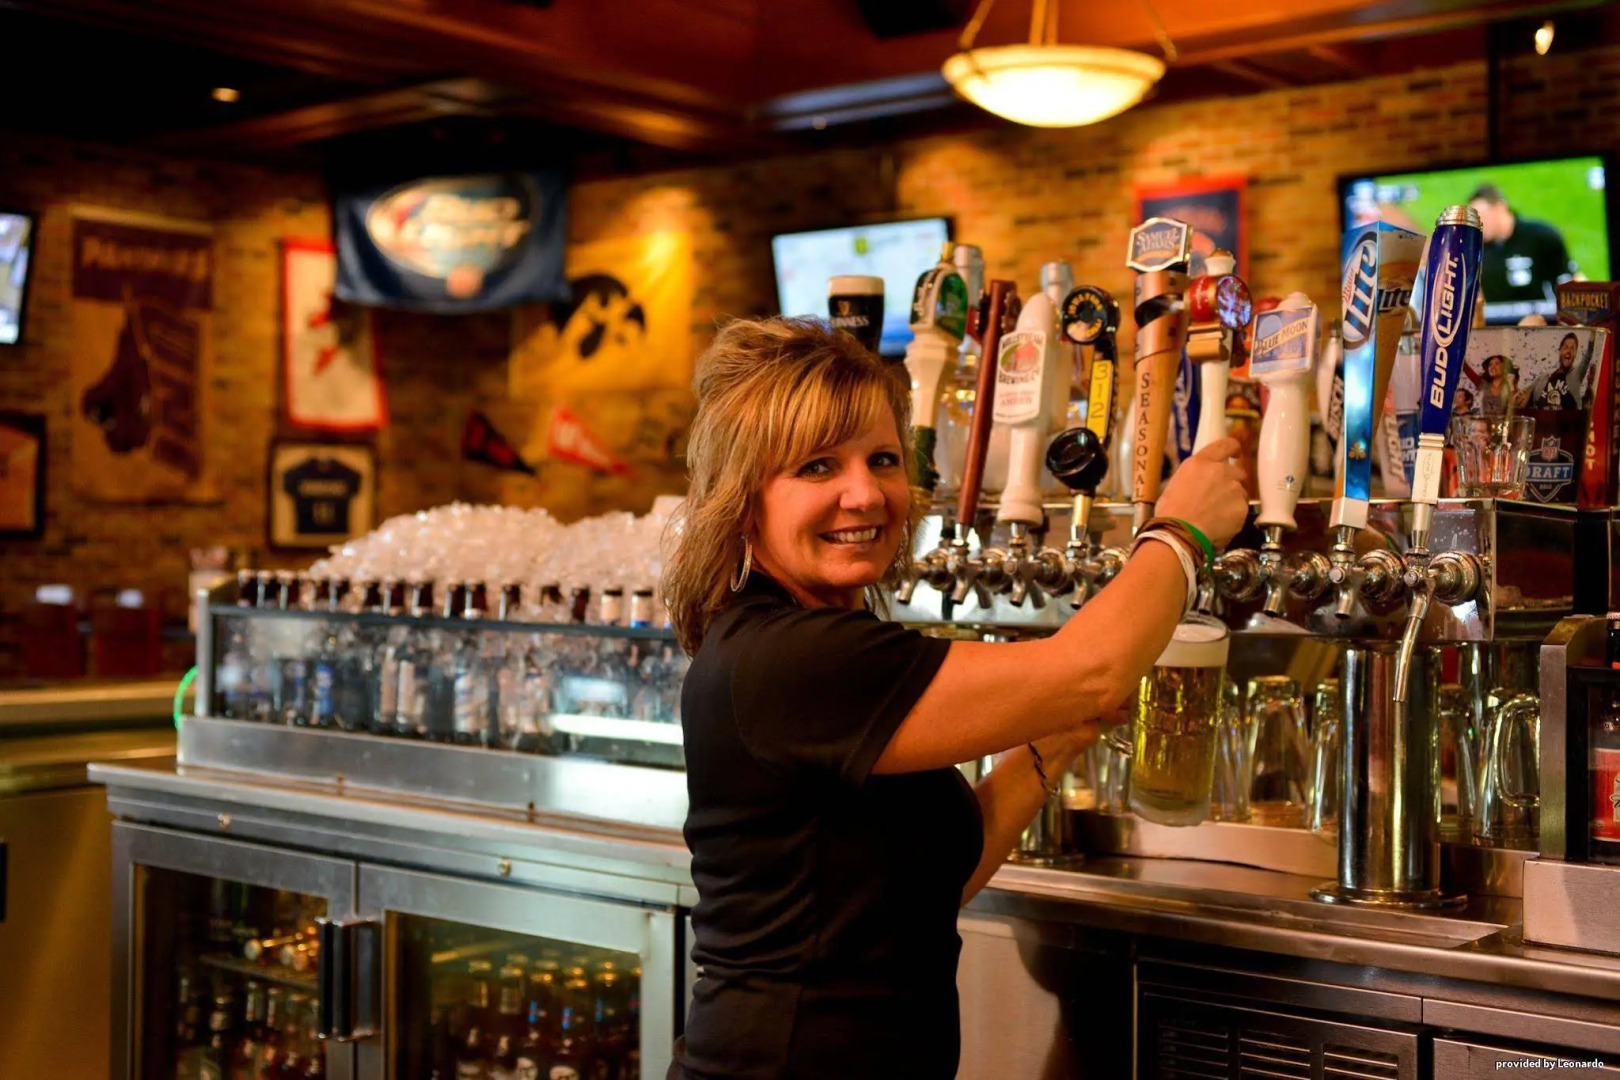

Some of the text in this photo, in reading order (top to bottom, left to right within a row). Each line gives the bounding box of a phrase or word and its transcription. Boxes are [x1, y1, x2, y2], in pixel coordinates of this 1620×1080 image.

[1561, 291, 1609, 309] BACKPOCKET
[1281, 319, 1309, 338] MOON
[1430, 251, 1459, 409] BUD LIGHT
[1090, 363, 1109, 419] 312
[1135, 372, 1151, 499] SEASONAL
